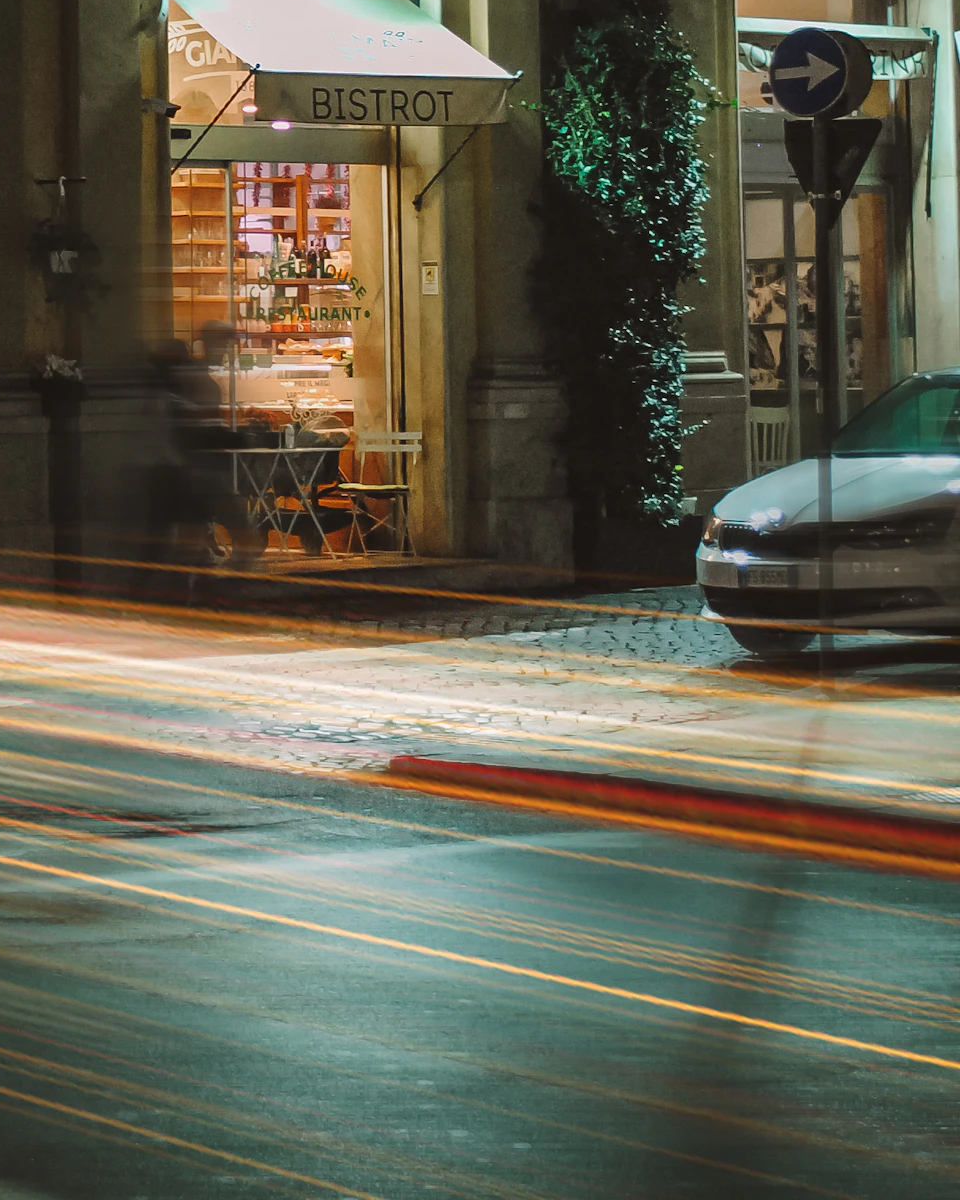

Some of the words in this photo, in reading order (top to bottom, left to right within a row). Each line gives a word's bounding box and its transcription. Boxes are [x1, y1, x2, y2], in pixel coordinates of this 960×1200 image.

[185, 40, 247, 67] GIA
[312, 87, 454, 122] BISTROT
[257, 307, 362, 321] RESTAURANT
